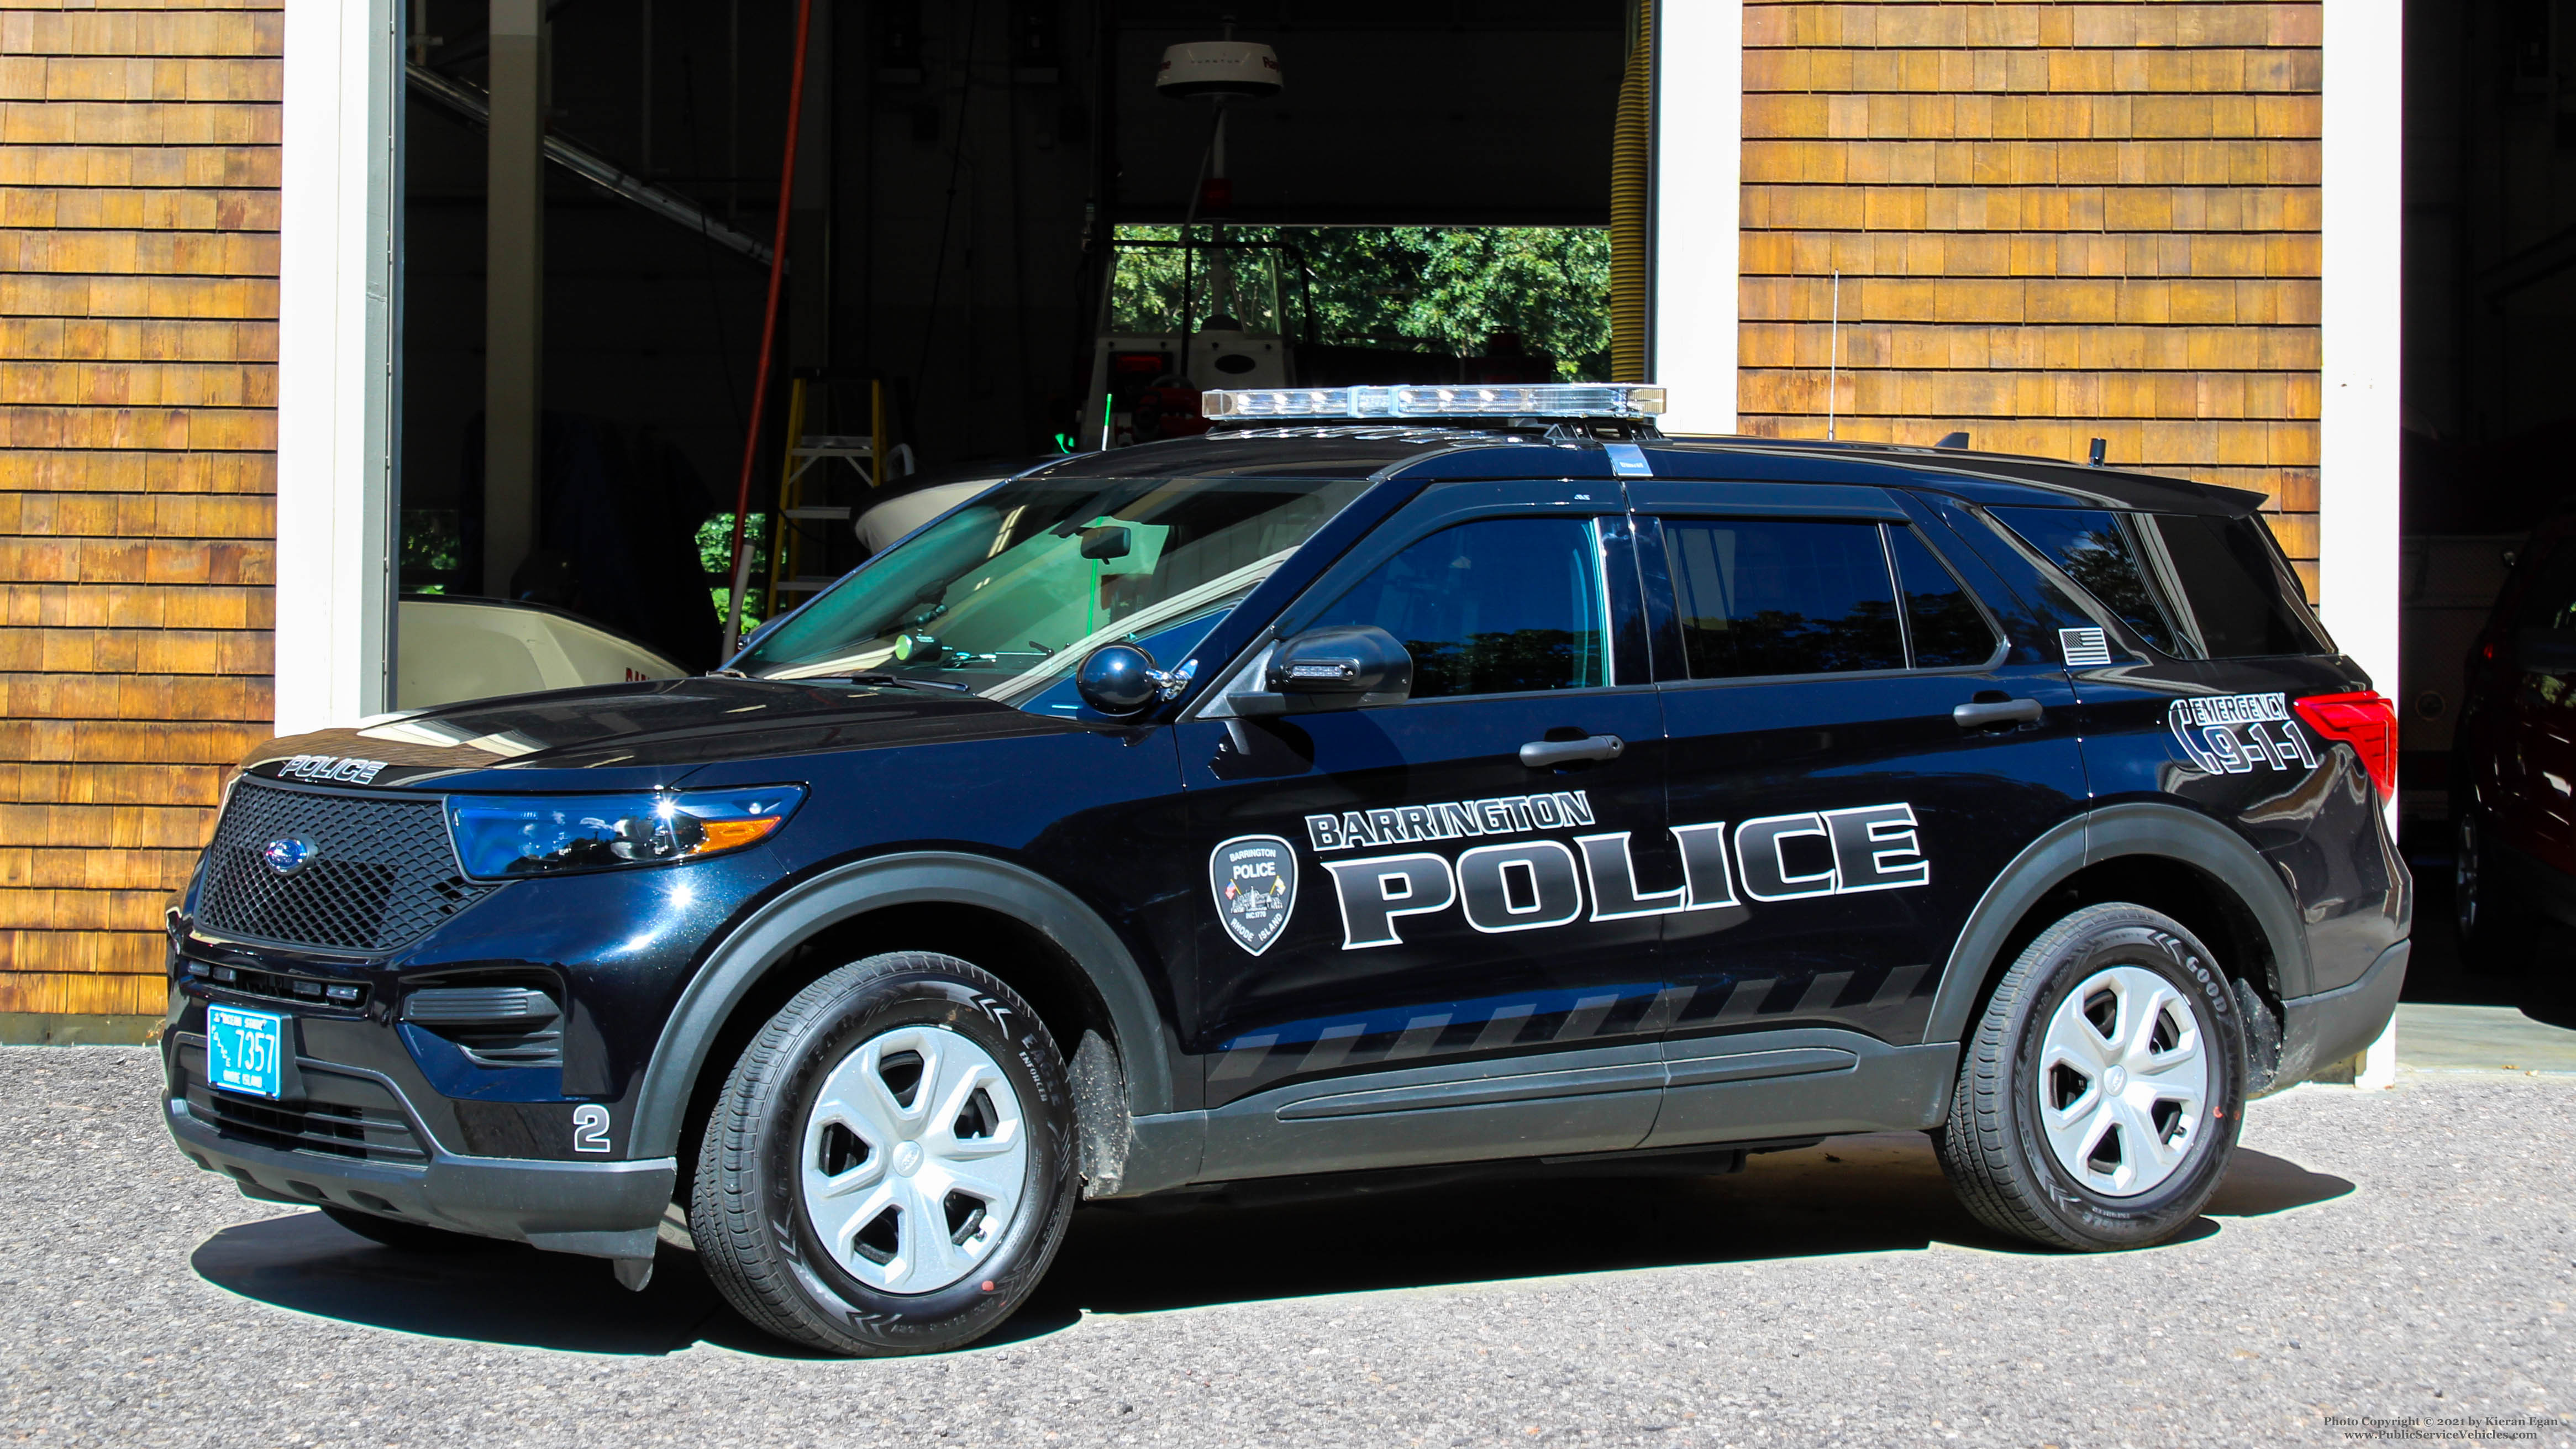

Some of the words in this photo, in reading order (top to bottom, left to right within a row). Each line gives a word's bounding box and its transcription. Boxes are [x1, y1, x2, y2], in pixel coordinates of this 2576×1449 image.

[2188, 692, 2290, 726] EMERGENCY
[2202, 720, 2319, 774] 9-1-1
[277, 755, 388, 785] POLICE
[1305, 790, 1596, 851] BARRINGTON
[1229, 848, 1276, 862] BARRINGTON
[1233, 862, 1276, 880] POLICE
[1320, 802, 1930, 950] POLICE
[1231, 917, 1254, 942] RHODE
[1258, 913, 1283, 942] ISLAND
[235, 1029, 276, 1073] 7357
[1018, 1051, 1048, 1102] ENFORCER
[573, 1103, 611, 1153] 2
